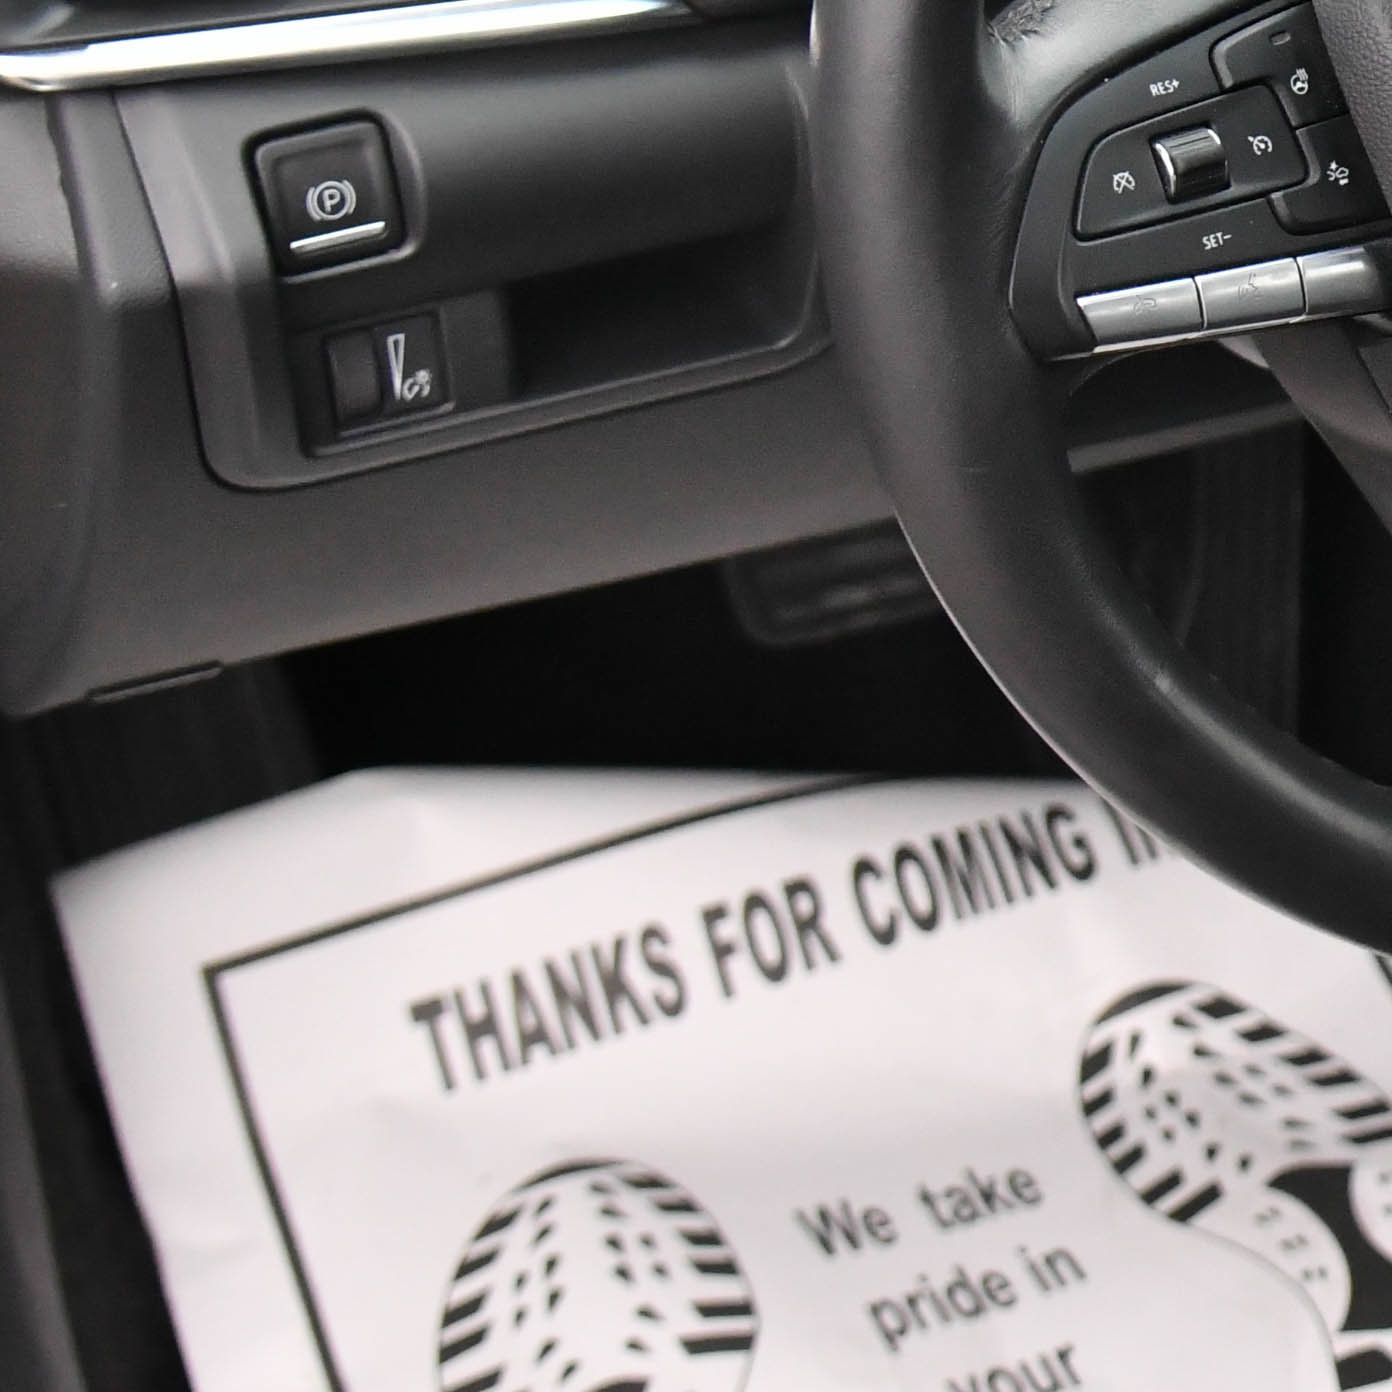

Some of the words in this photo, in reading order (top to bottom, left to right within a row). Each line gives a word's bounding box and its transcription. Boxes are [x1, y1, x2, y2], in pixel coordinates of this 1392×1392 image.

[409, 920, 688, 1092] THANKS
[701, 873, 842, 999] FOR
[851, 801, 1097, 947] COMING
[1103, 796, 1161, 867] I
[795, 1198, 898, 1256] We
[917, 1166, 1044, 1230] take
[868, 1264, 1017, 1353] pride
[1018, 1244, 1088, 1293] in
